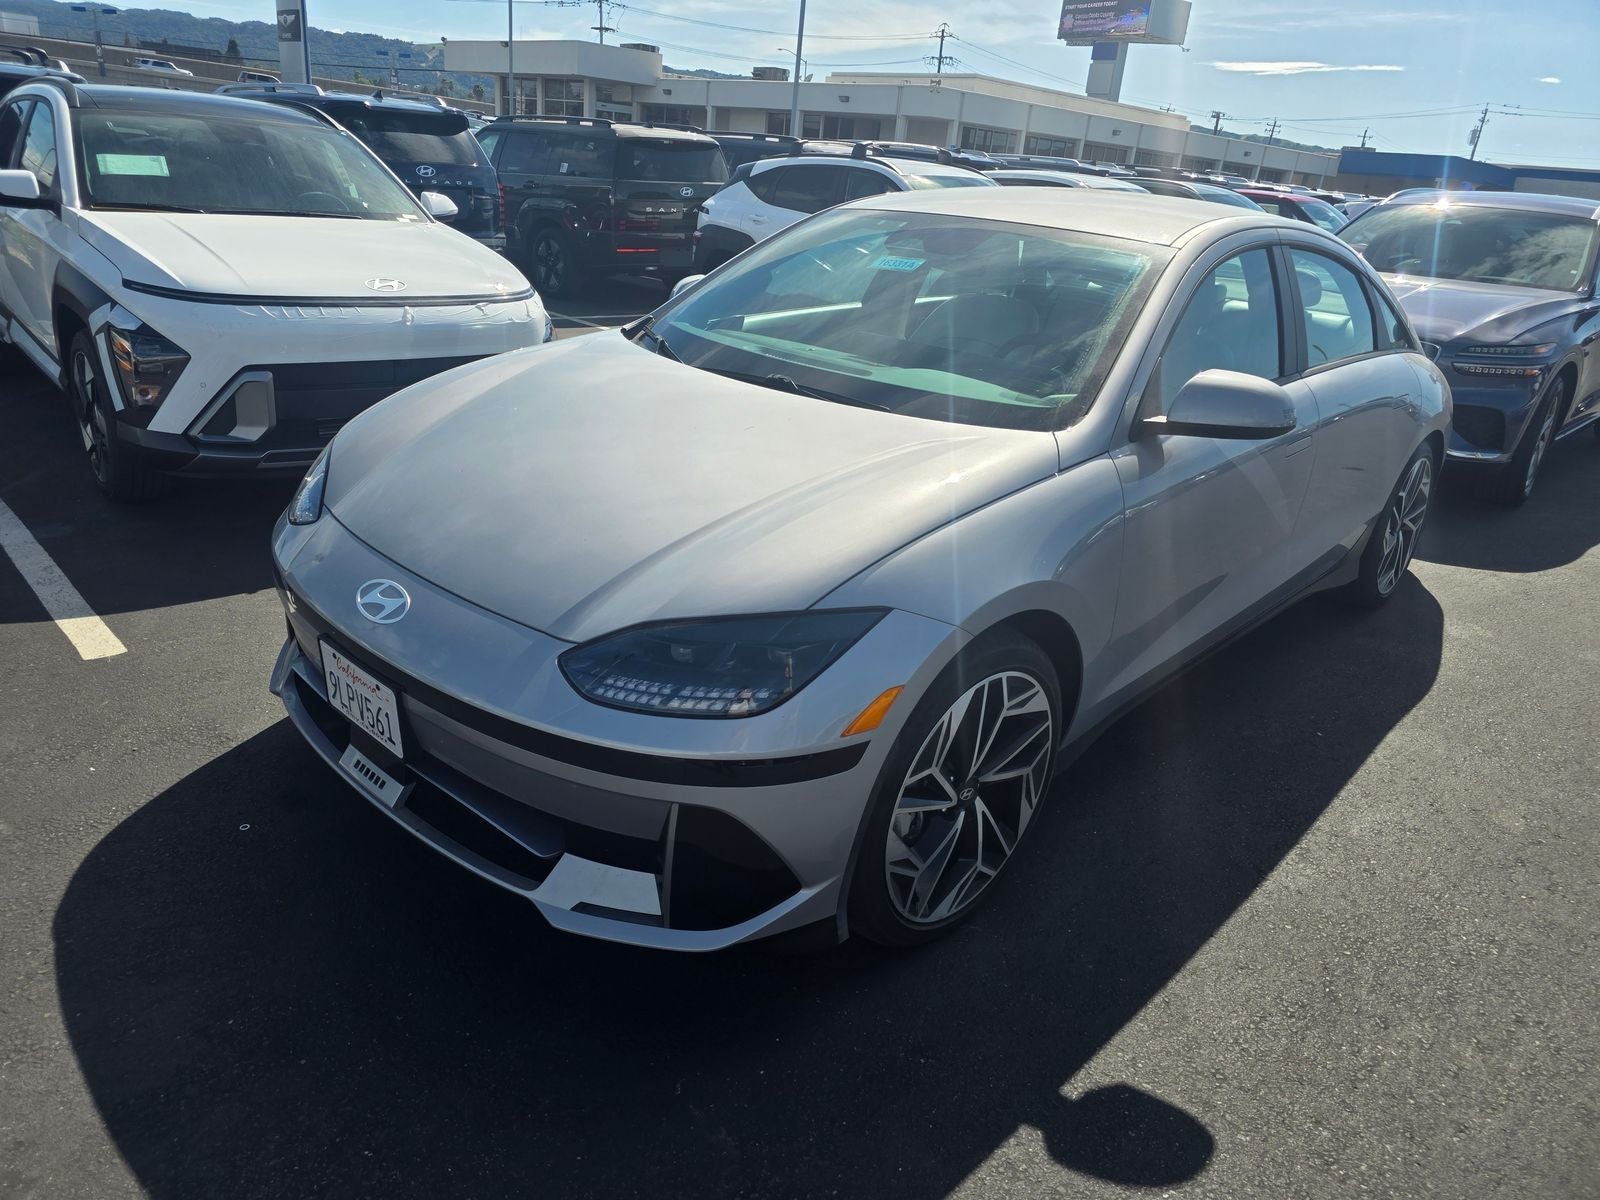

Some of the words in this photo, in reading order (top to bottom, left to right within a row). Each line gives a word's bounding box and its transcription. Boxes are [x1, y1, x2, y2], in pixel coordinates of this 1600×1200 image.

[405, 178, 473, 186] LISADE
[645, 206, 700, 214] SANTA
[335, 656, 383, 701] California
[328, 670, 396, 746] 9LPV561
